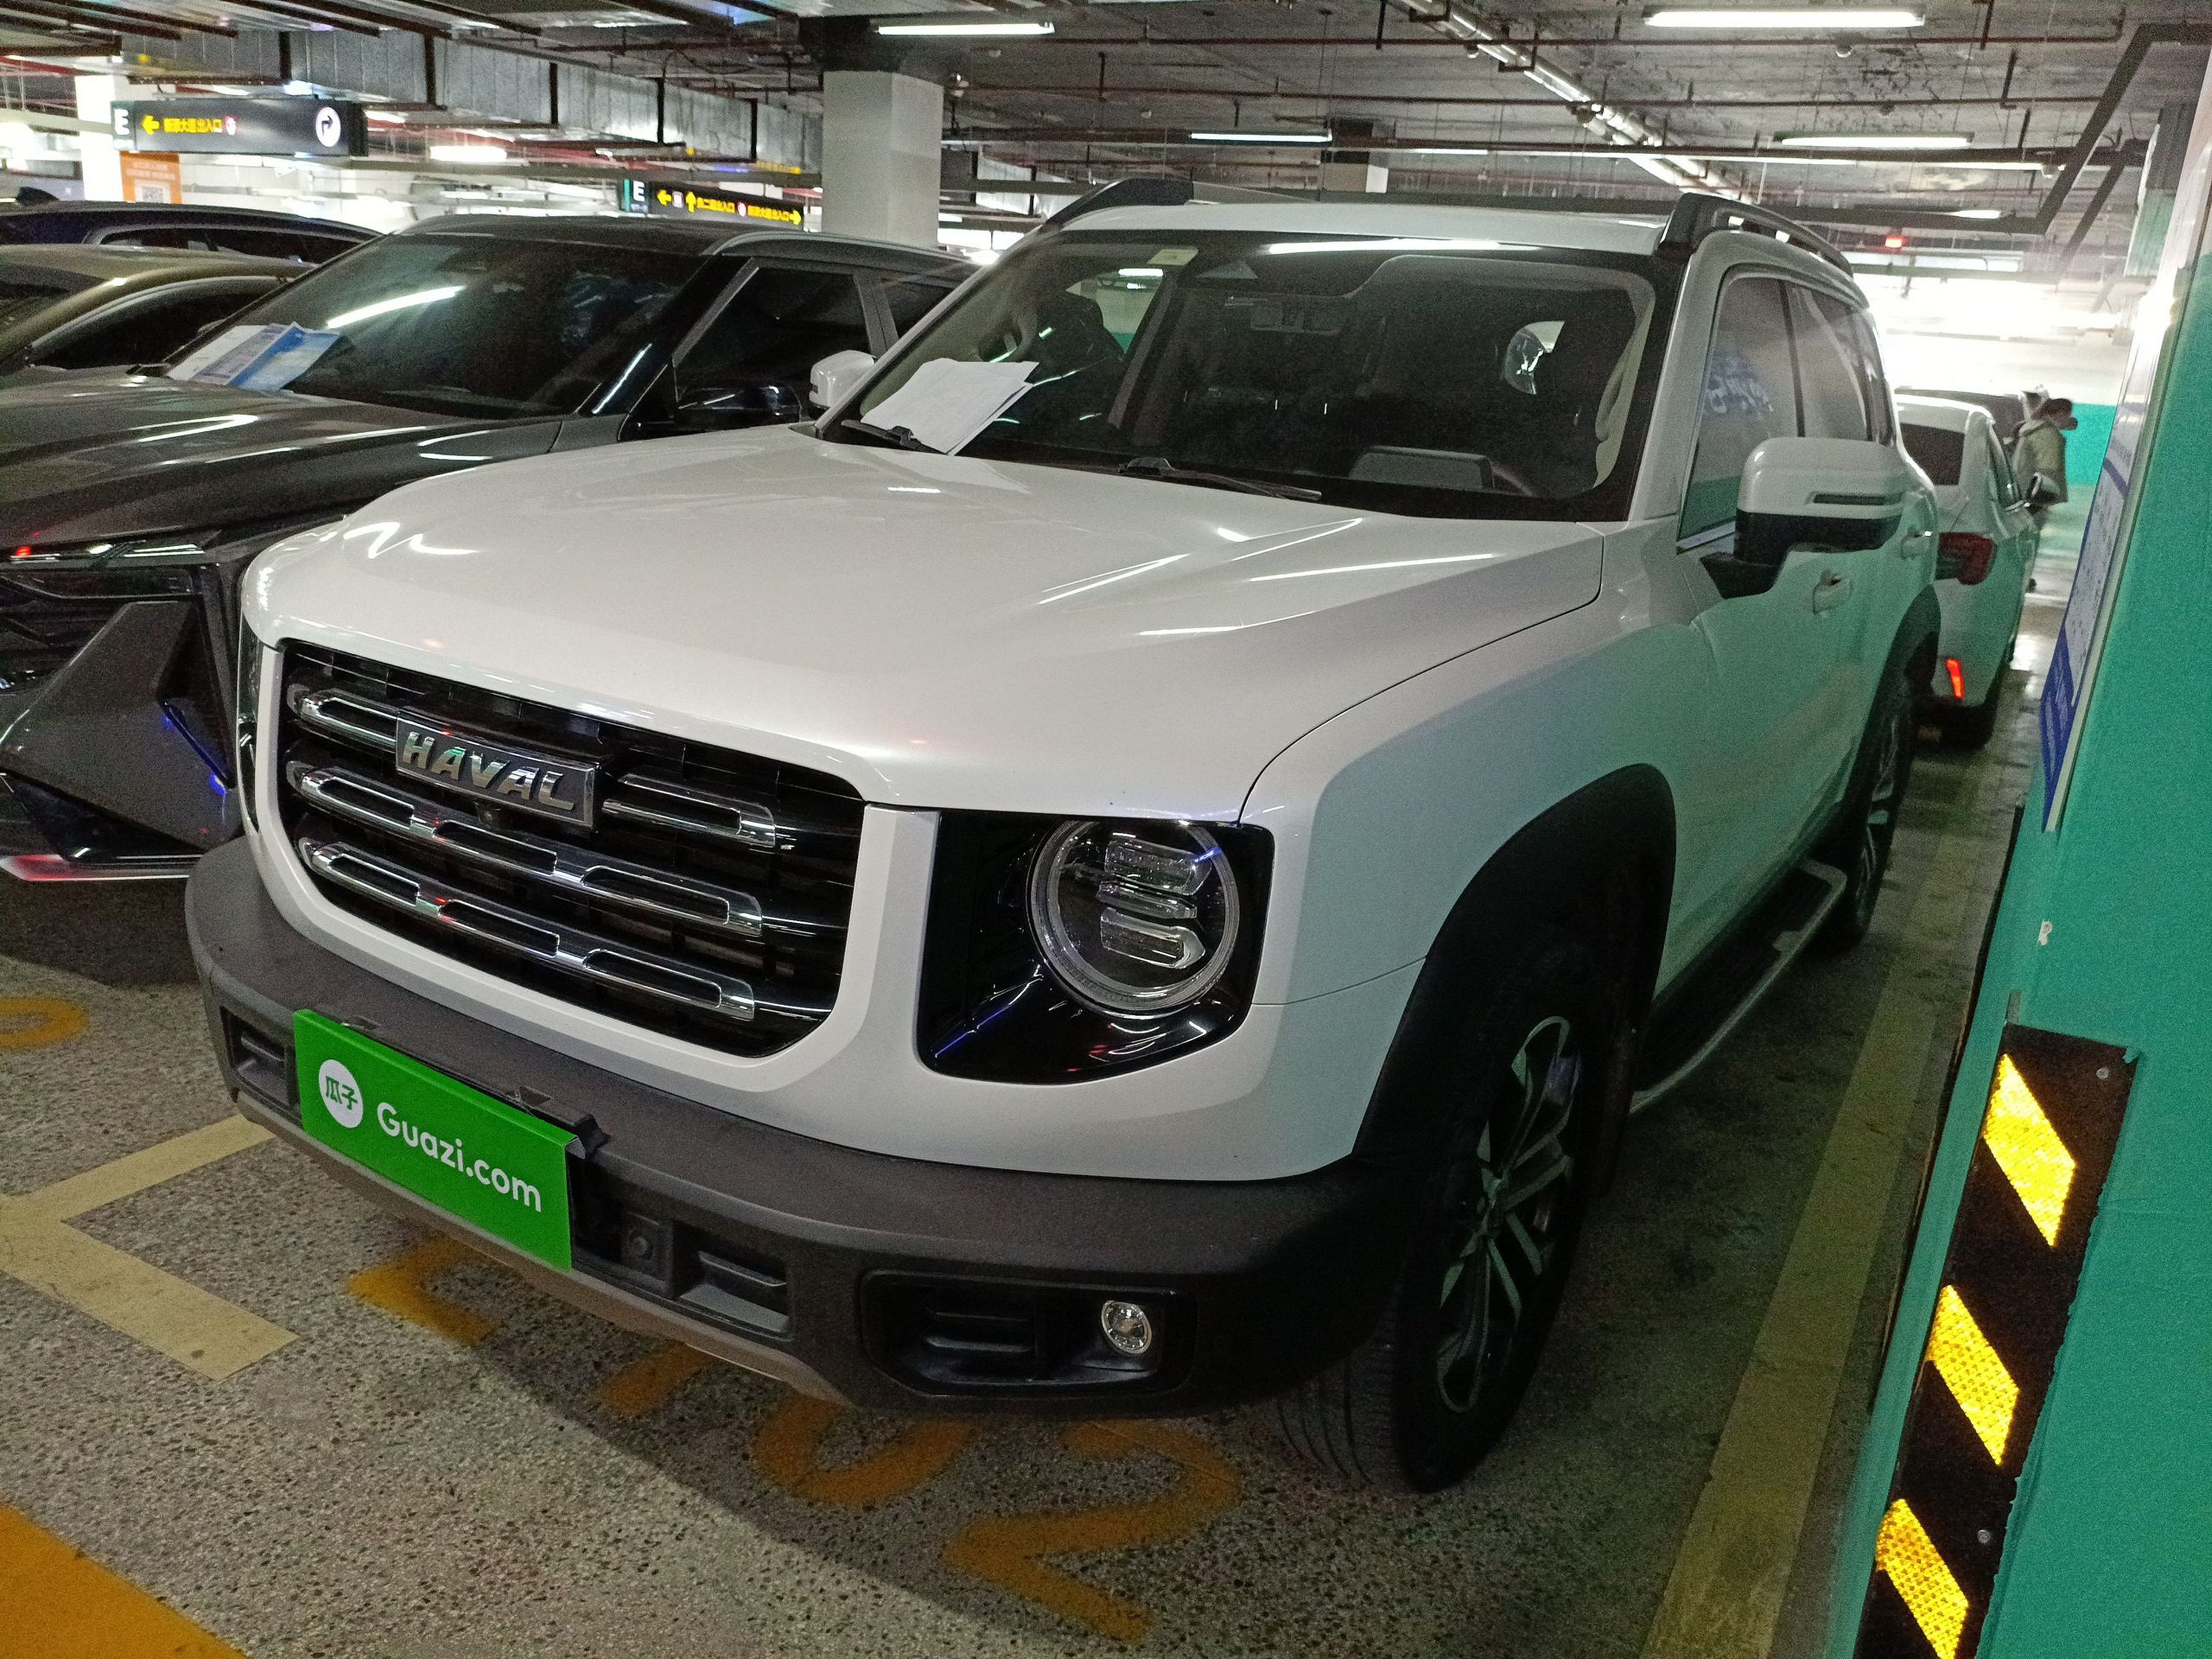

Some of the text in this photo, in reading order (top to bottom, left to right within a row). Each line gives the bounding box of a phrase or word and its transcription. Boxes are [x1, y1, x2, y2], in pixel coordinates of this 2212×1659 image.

[114, 108, 130, 135] E
[632, 180, 645, 202] E
[403, 730, 576, 811] HAVAL
[325, 1075, 358, 1111] 瓜子
[377, 1101, 541, 1213] Guazi.com
